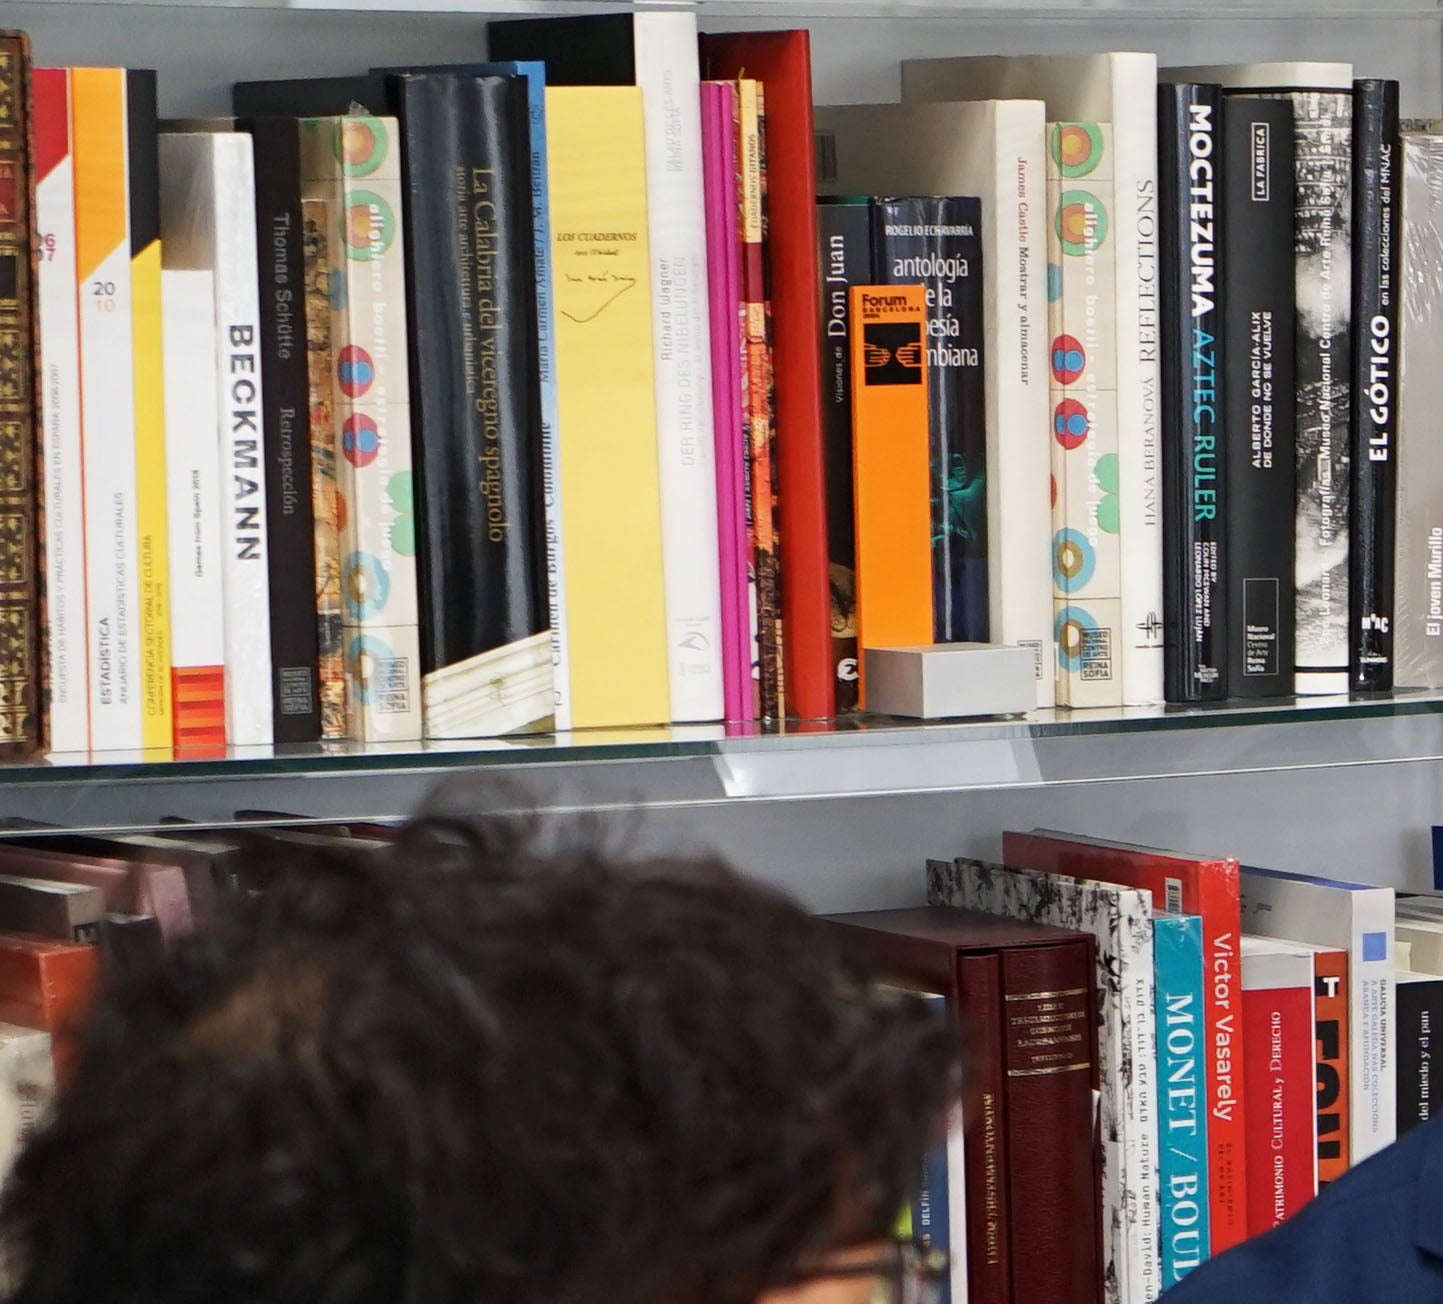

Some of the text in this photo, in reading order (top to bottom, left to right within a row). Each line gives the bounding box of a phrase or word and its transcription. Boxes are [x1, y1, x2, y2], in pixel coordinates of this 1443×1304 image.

[1256, 128, 1266, 196] LA FABRICA
[556, 232, 637, 242] LOS CUADERNOS
[885, 223, 974, 237] ROGELIO ECHAVARRÍA
[893, 253, 969, 283] antología
[1136, 178, 1157, 364] REFLECTIONS
[1380, 143, 1392, 305] en las colecciones del MNAC
[93, 282, 116, 296] 20
[659, 258, 673, 360] Richard Wagner
[826, 235, 848, 403] Visiones de Don Juan
[862, 295, 907, 306] Forum
[1188, 104, 1216, 522] MOCTEZUMA AZTEC RULER
[272, 212, 295, 514] Thomas Schütte Retrospección
[472, 168, 510, 542] La Calabria del viceregno spagnolo
[1262, 311, 1272, 468] DE DONDE NO SE VUELVE
[1364, 315, 1389, 461] EL GÓTICO
[228, 324, 261, 560] BECKMANN
[1251, 405, 1261, 468] ALBERTO
[1143, 475, 1156, 526] HANA
[1426, 527, 1443, 636] El joven Murillo
[99, 618, 112, 704] ESTADÍSTICA
[1165, 992, 1197, 1137] MONET
[1212, 932, 1238, 1122] Victor Vasarely
[1269, 1011, 1283, 1072] DERECHO
[1379, 979, 1388, 1071] GALICIA UNIVERSAL
[1418, 1010, 1432, 1121] del miedo y el pan
[1139, 1133, 1150, 1173] Nature
[1270, 1086, 1285, 1150] CULTURAL
[1141, 1177, 1152, 1228] Human
